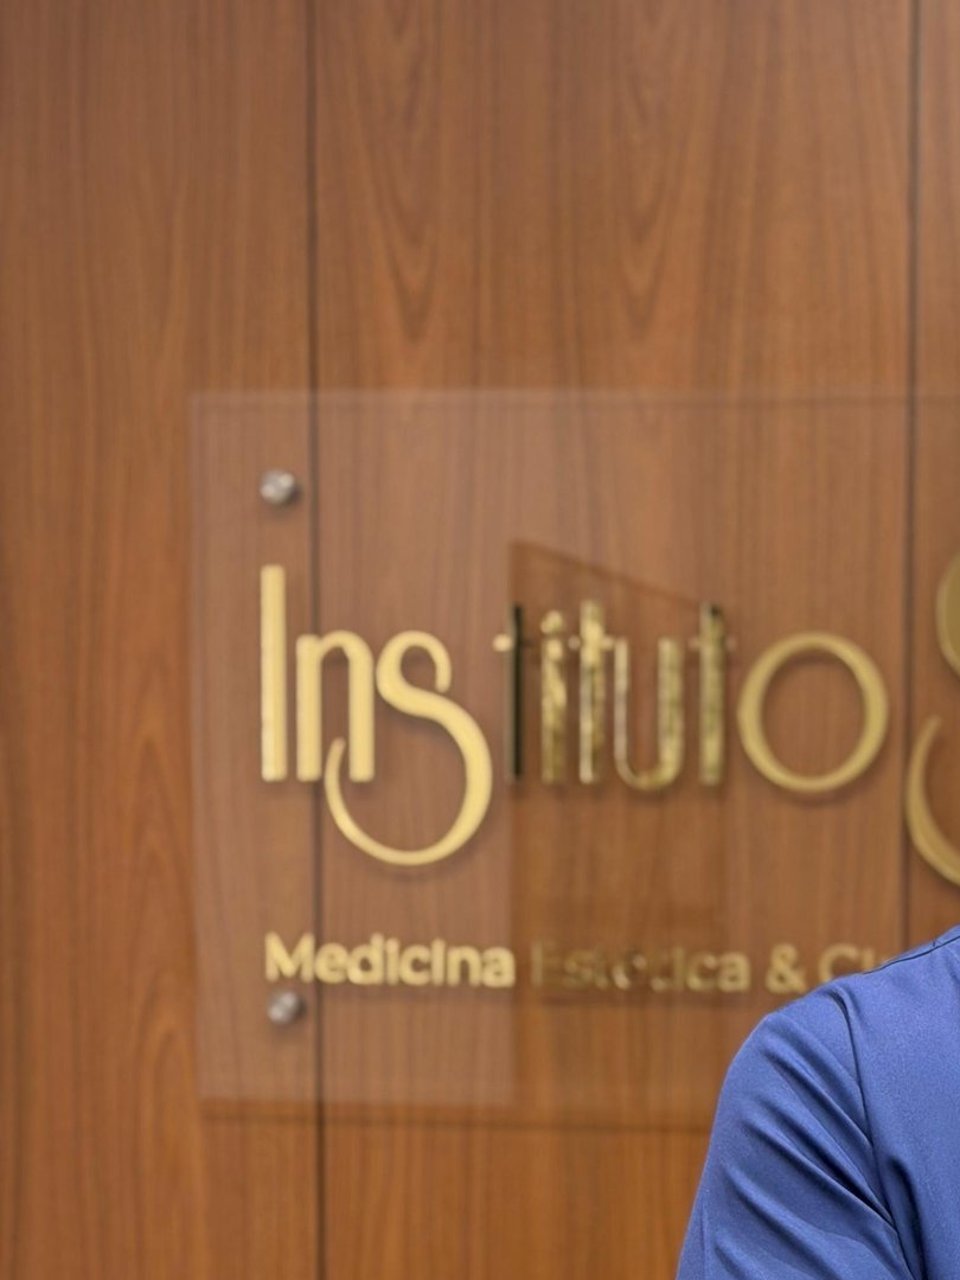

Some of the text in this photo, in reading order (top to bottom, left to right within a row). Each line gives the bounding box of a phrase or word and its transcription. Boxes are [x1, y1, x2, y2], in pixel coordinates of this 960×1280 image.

[260, 564, 888, 866] Instituto
[264, 931, 516, 988] Medicina
[766, 944, 808, 994] &
